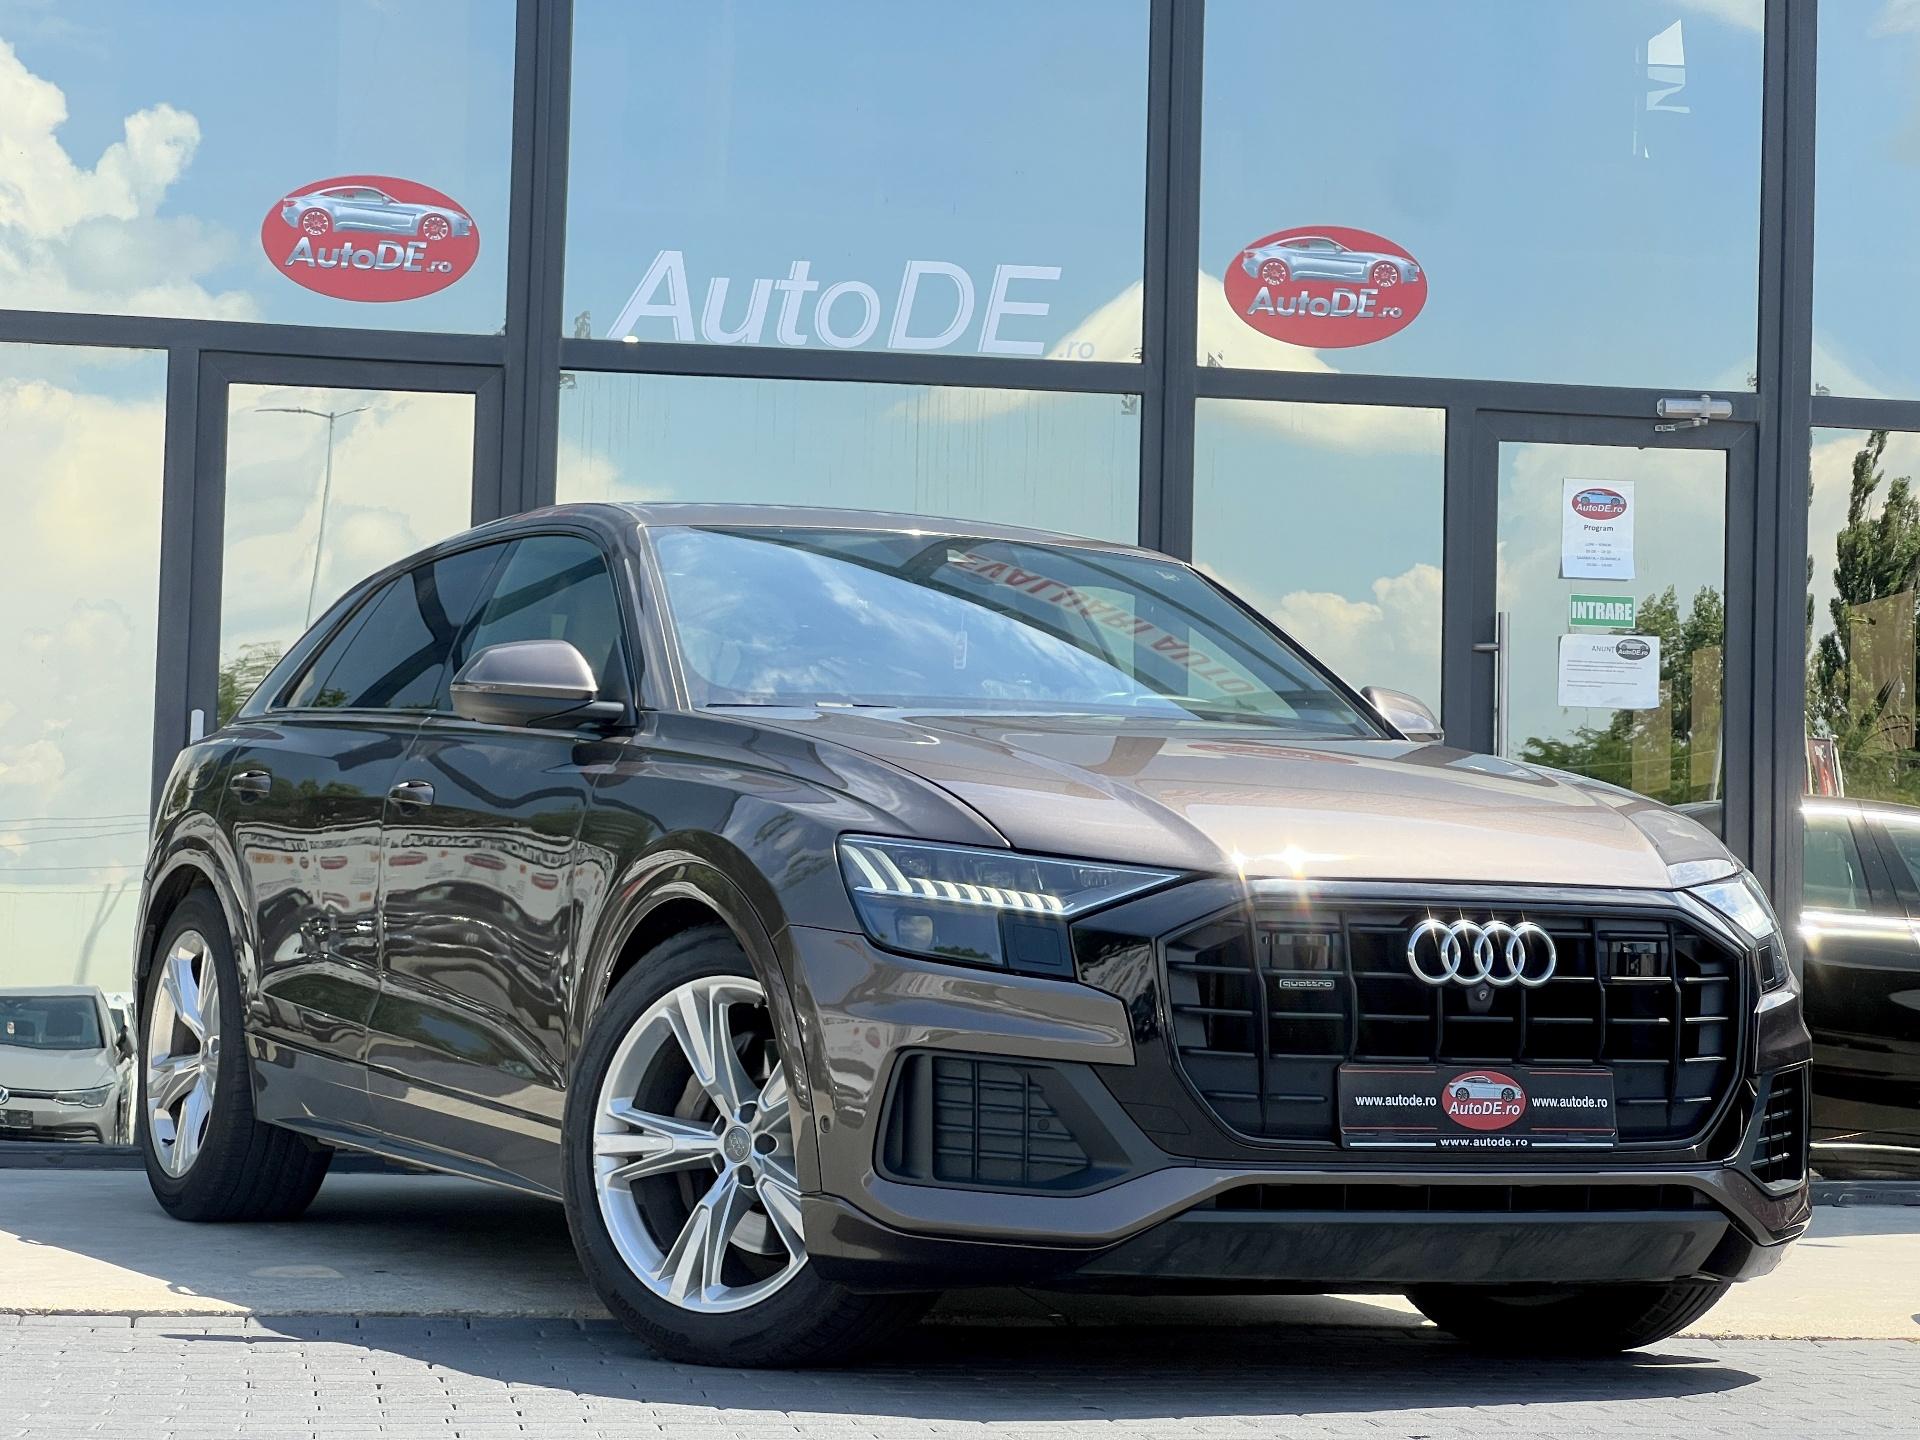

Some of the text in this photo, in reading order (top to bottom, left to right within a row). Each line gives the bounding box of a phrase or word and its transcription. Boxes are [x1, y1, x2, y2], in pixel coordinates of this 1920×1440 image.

[1576, 503, 1623, 513] AutoDE.ro
[1583, 524, 1614, 533] Program
[1571, 601, 1633, 621] INTRARE
[1355, 1094, 1608, 1117] www.autode.ro AutoDE.ro www.autode.ro
[1440, 1137, 1528, 1148] www.autode.ro
